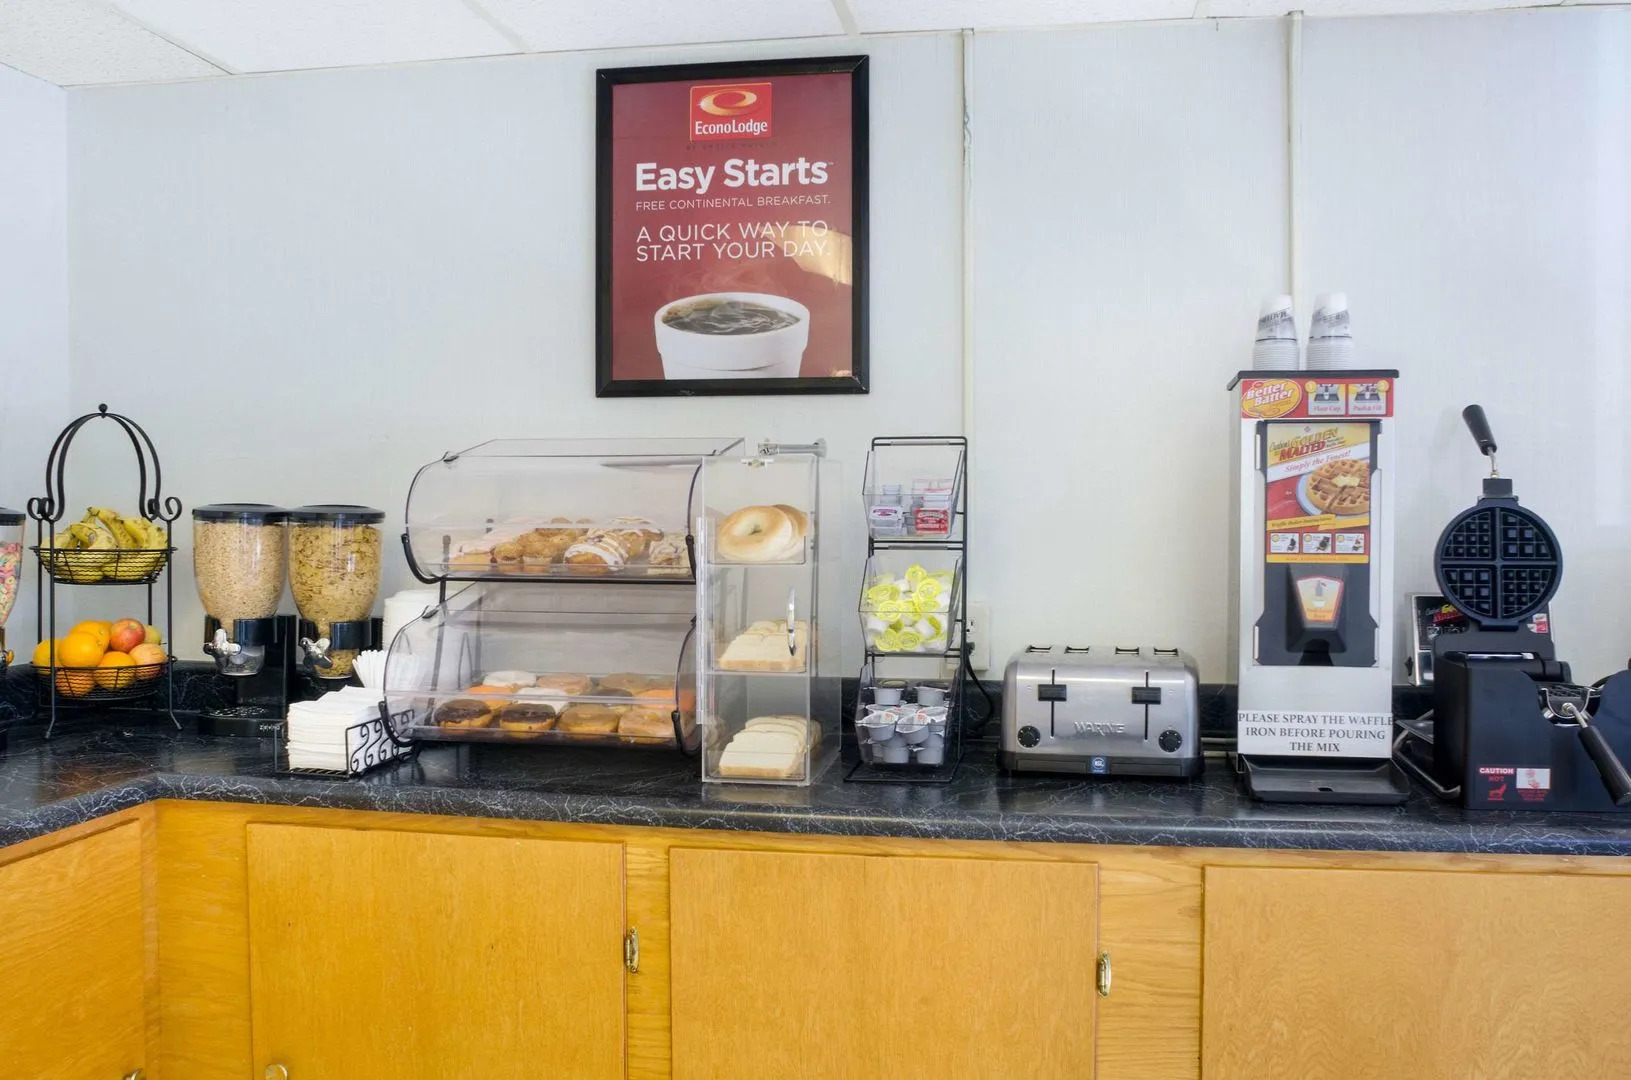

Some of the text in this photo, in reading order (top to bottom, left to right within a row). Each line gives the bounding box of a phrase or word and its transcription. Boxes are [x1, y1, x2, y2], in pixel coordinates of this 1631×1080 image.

[695, 118, 768, 136] EconoLodge
[636, 157, 828, 194] Easy Starts
[636, 194, 831, 211] FREE CONTINENTAL BREAKFAST.
[636, 220, 828, 243] A QUICK WAY TO
[636, 240, 831, 262] START YOUR DAY.
[1279, 440, 1326, 461] MALTED
[1284, 460, 1311, 473] Simply
[1312, 455, 1325, 467] the
[1238, 713, 1393, 726] PLEASE SPRAY THE WAFFLE
[1246, 727, 1386, 740] IRON BEFORE POURING
[1289, 741, 1341, 752] THE MIX
[1479, 767, 1515, 775] CAUTION
